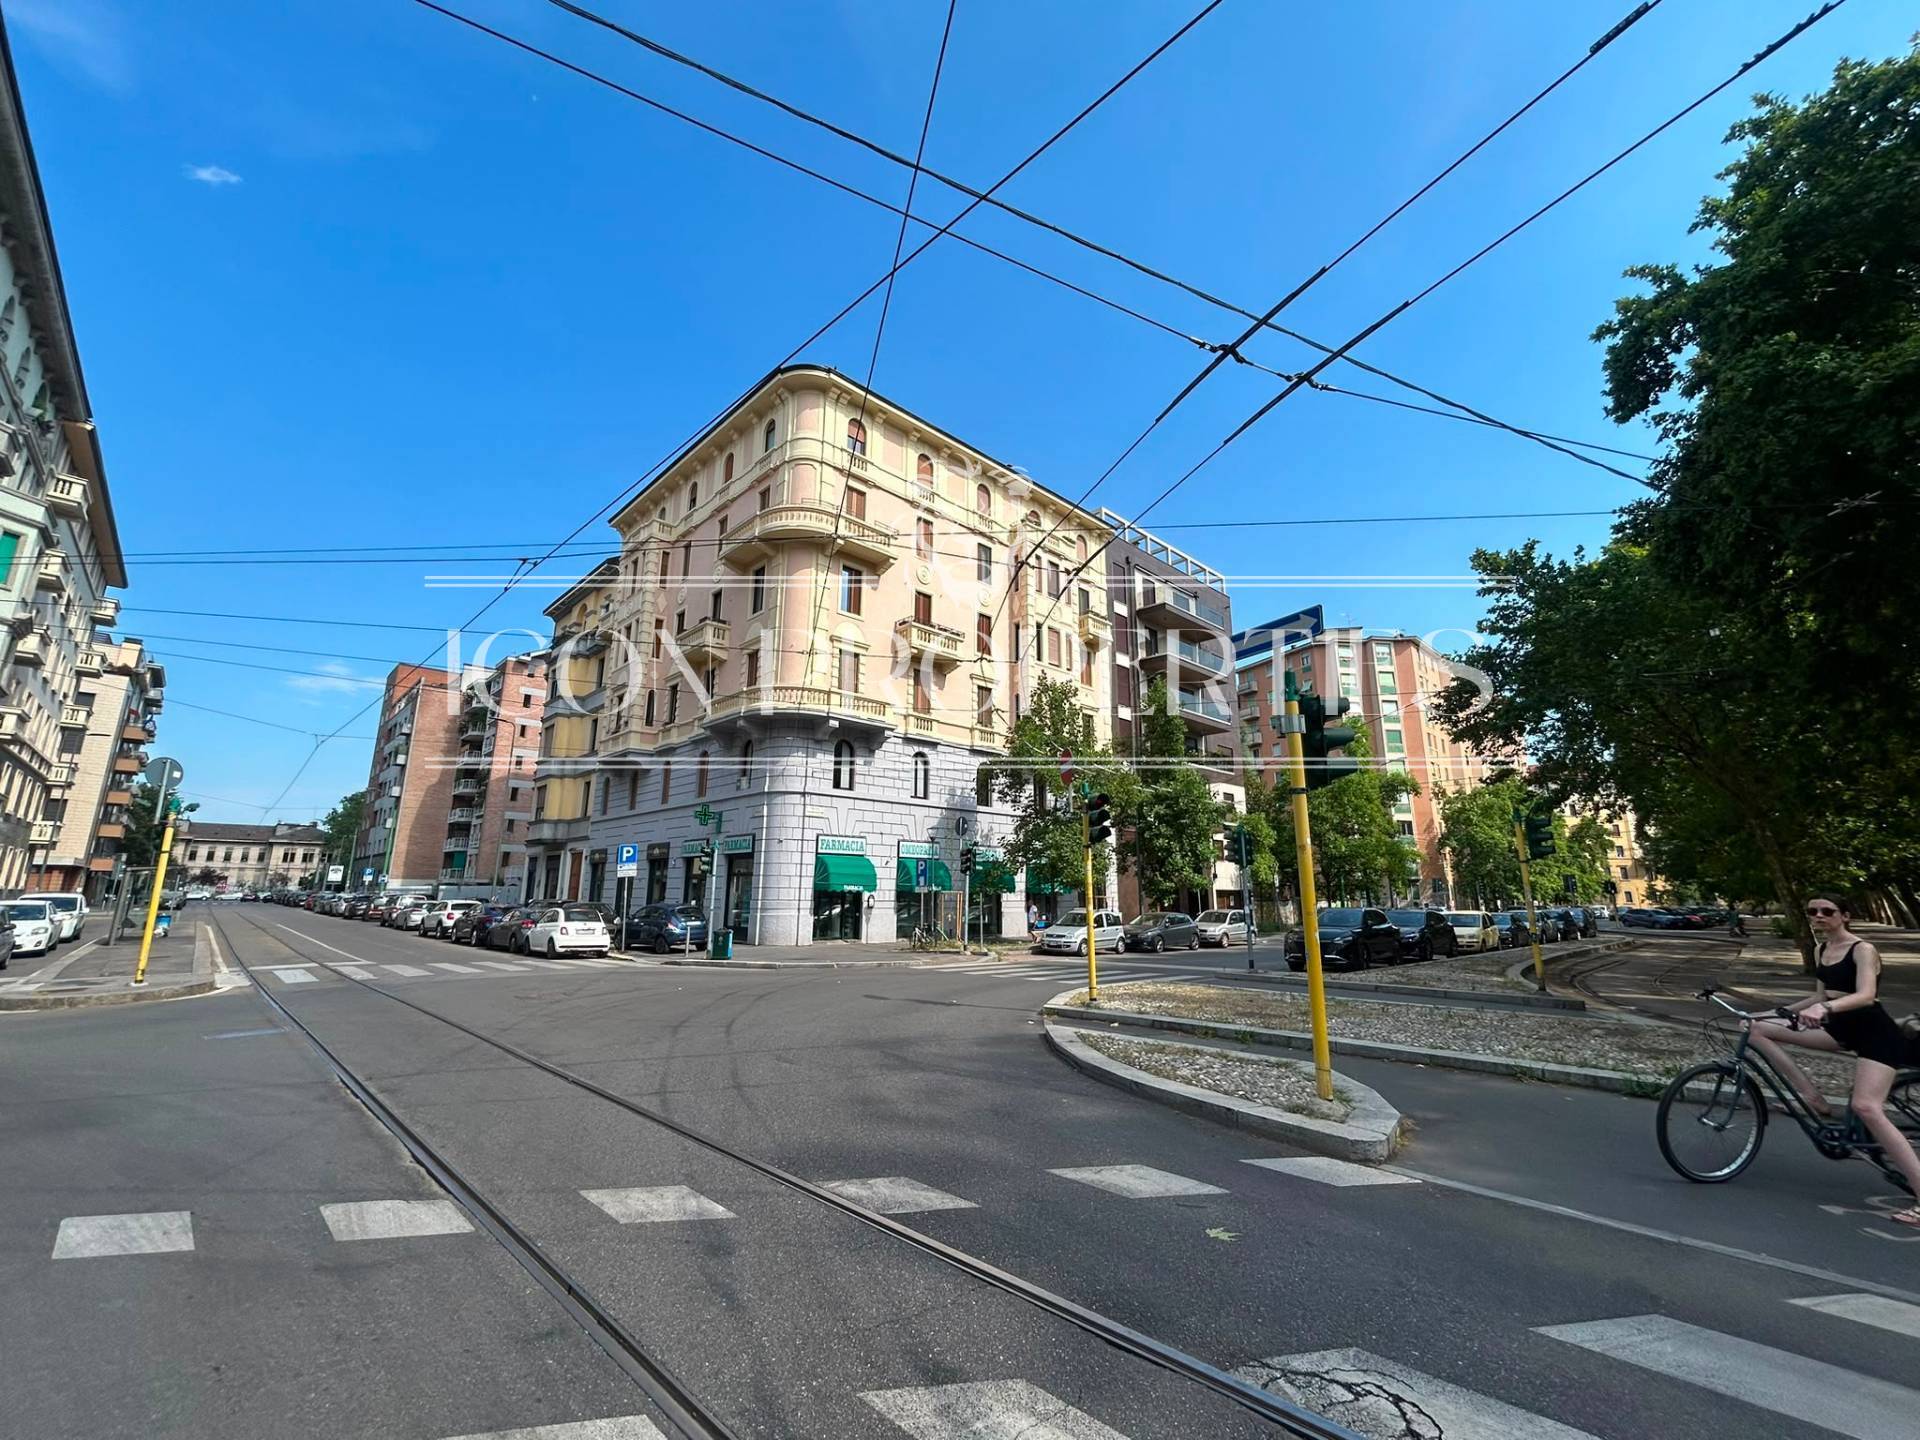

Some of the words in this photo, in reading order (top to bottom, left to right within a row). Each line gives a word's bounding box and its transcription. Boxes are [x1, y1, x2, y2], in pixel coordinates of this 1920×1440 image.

[724, 838, 752, 850] FARMACIA
[820, 838, 865, 852] FARMACIA
[622, 847, 634, 862] P
[918, 861, 926, 875] P
